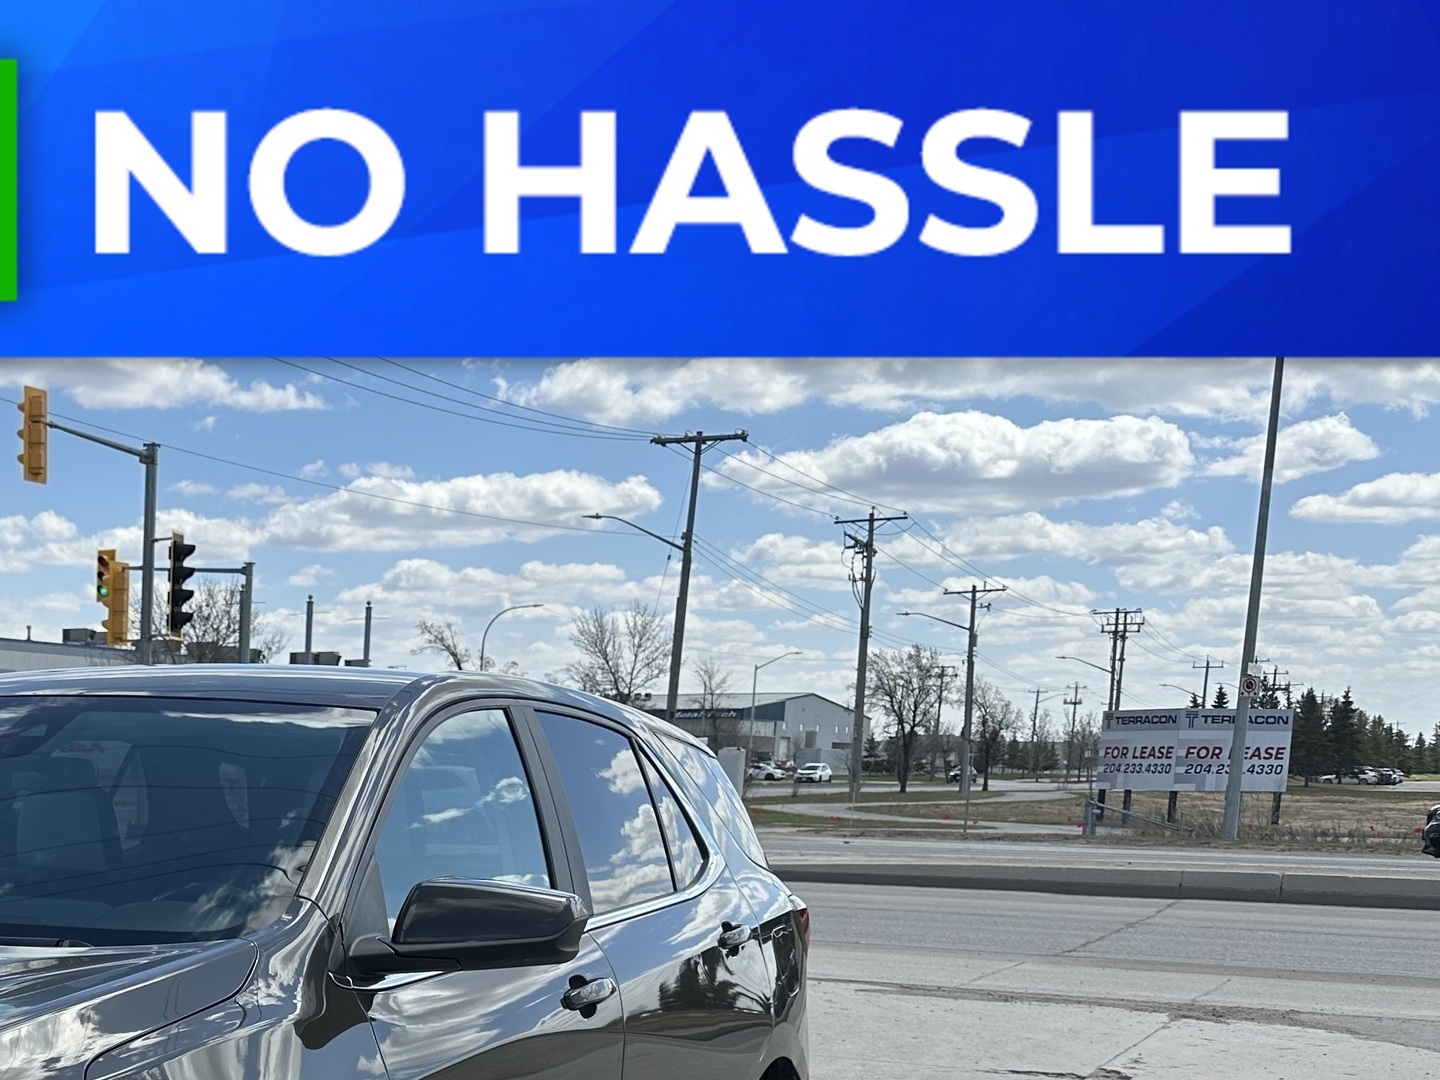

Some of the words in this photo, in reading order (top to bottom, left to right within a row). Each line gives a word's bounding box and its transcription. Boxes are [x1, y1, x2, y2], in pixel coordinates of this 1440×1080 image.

[1115, 715, 1178, 725] TERRACON
[1201, 715, 1290, 725] TERACON
[1103, 746, 1129, 759] FOR
[1132, 746, 1174, 759] LEASE
[1184, 746, 1223, 760] FOR
[1103, 763, 1172, 774] 204.233.4330
[1184, 763, 1284, 775] 204.23.4330
